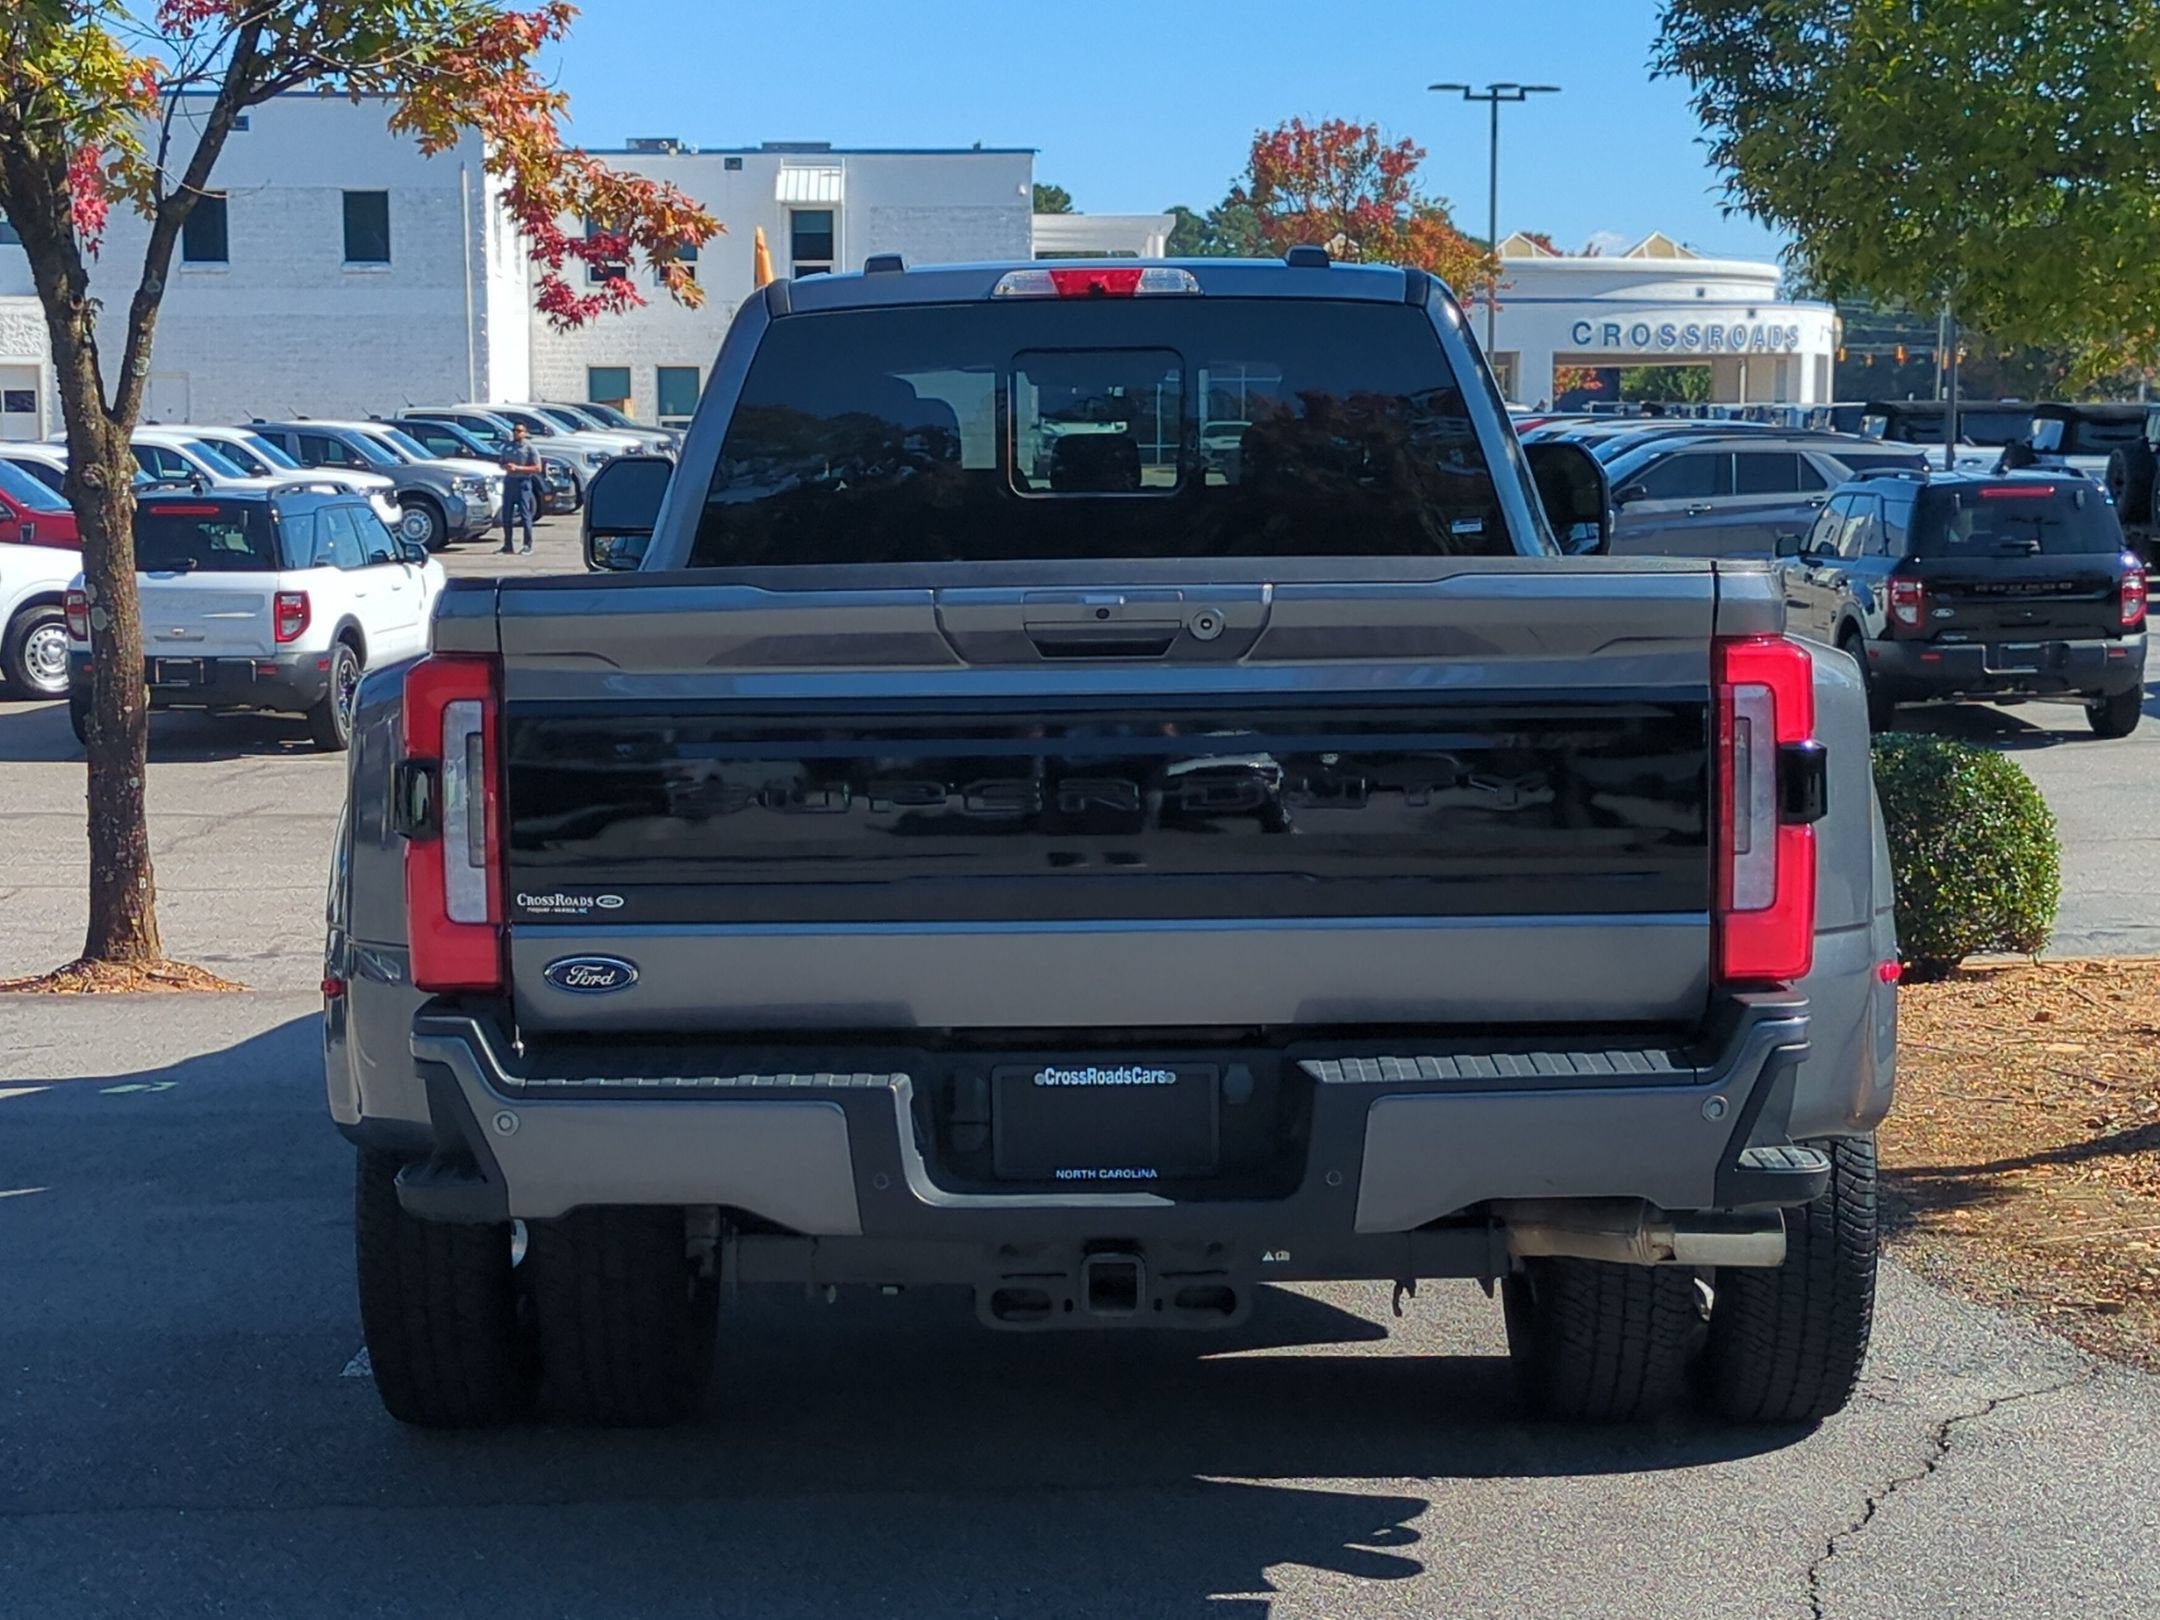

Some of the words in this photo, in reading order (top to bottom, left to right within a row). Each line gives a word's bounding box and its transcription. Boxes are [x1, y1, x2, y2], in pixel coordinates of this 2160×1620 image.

[1572, 321, 1799, 347] CROSSROADS
[566, 965, 616, 985] Ford
[1044, 1066, 1166, 1085] CrossRoadsCars
[1055, 1169, 1096, 1179] NORTH
[1099, 1168, 1158, 1179] CAROLINA
